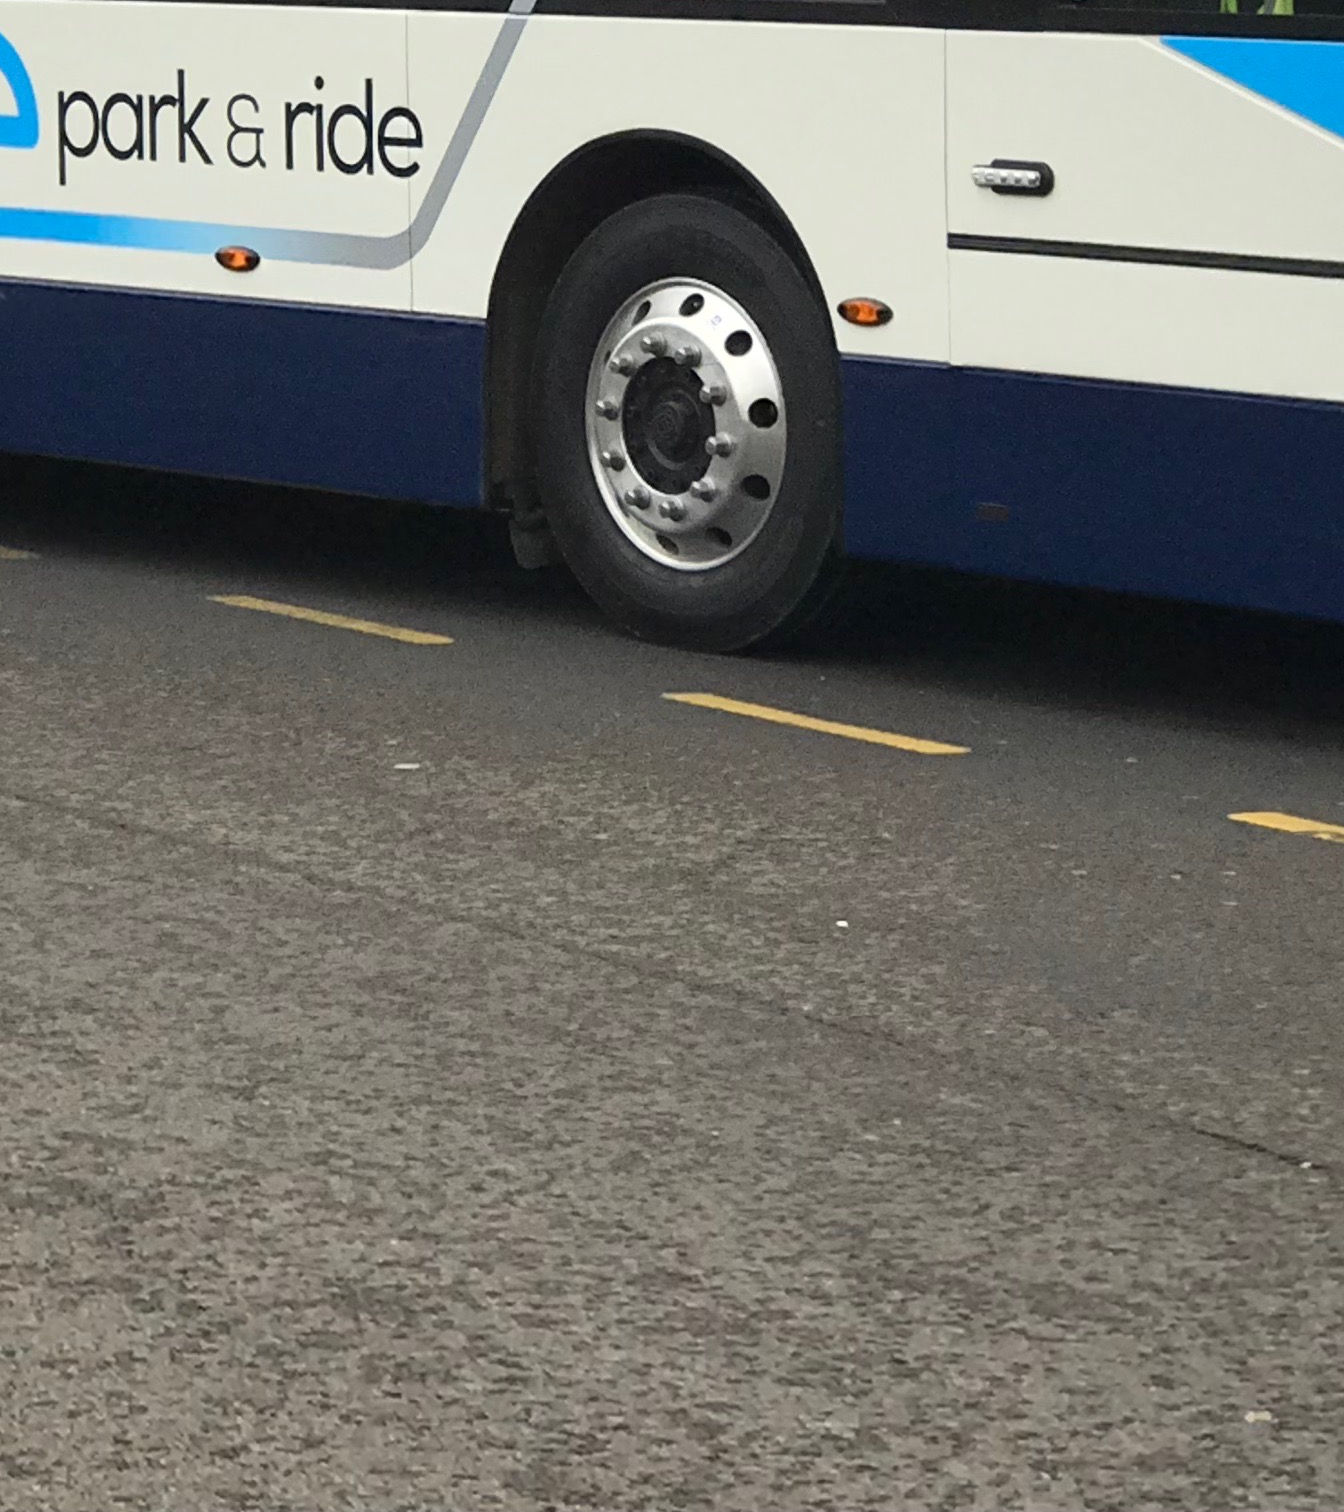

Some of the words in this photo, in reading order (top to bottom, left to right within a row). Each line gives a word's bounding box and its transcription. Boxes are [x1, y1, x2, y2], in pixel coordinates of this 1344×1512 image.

[58, 68, 214, 186] park
[226, 93, 267, 169] &
[285, 75, 424, 178] ride
